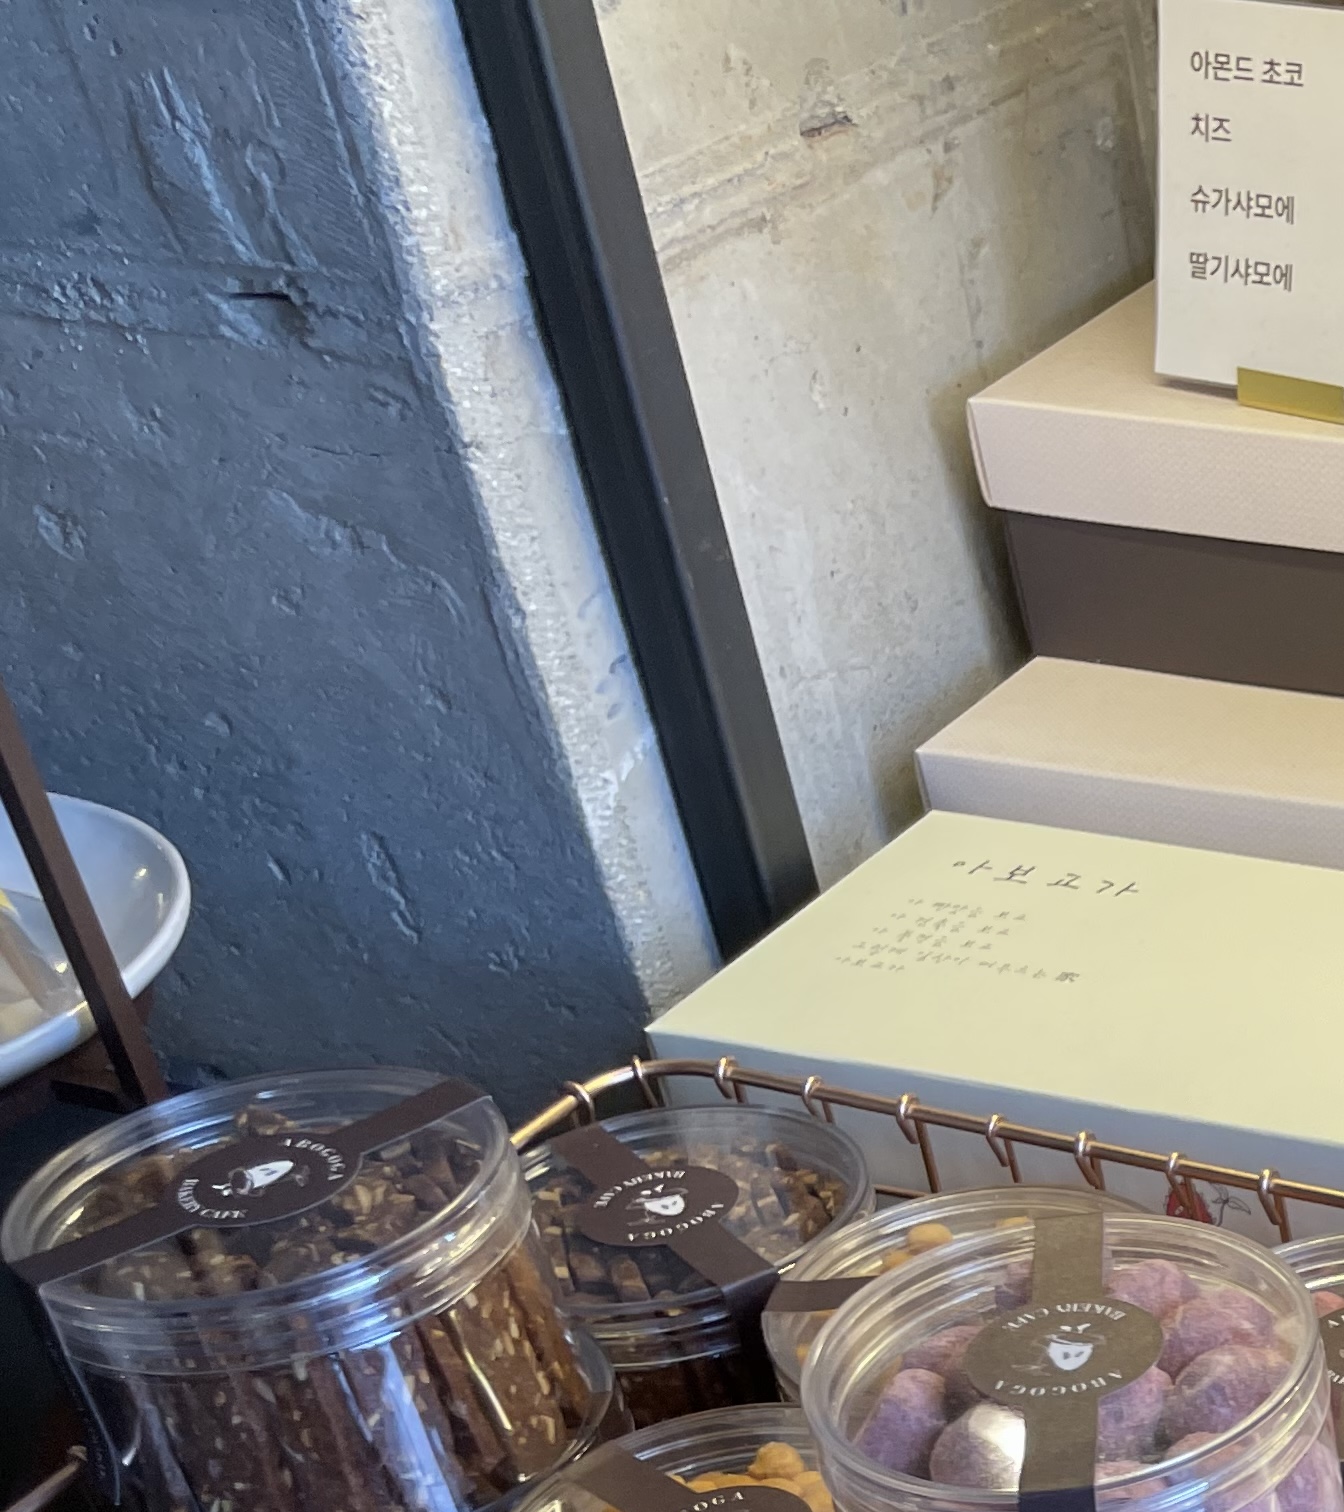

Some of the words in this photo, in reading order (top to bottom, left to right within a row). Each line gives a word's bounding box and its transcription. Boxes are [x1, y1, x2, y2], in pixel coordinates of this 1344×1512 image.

[1190, 50, 1254, 82] 아몬드
[1261, 57, 1304, 88] 초코
[1190, 113, 1232, 142] 치즈
[1190, 185, 1295, 225] 슈가샤모에
[1189, 251, 1294, 292] 딸기샤모에
